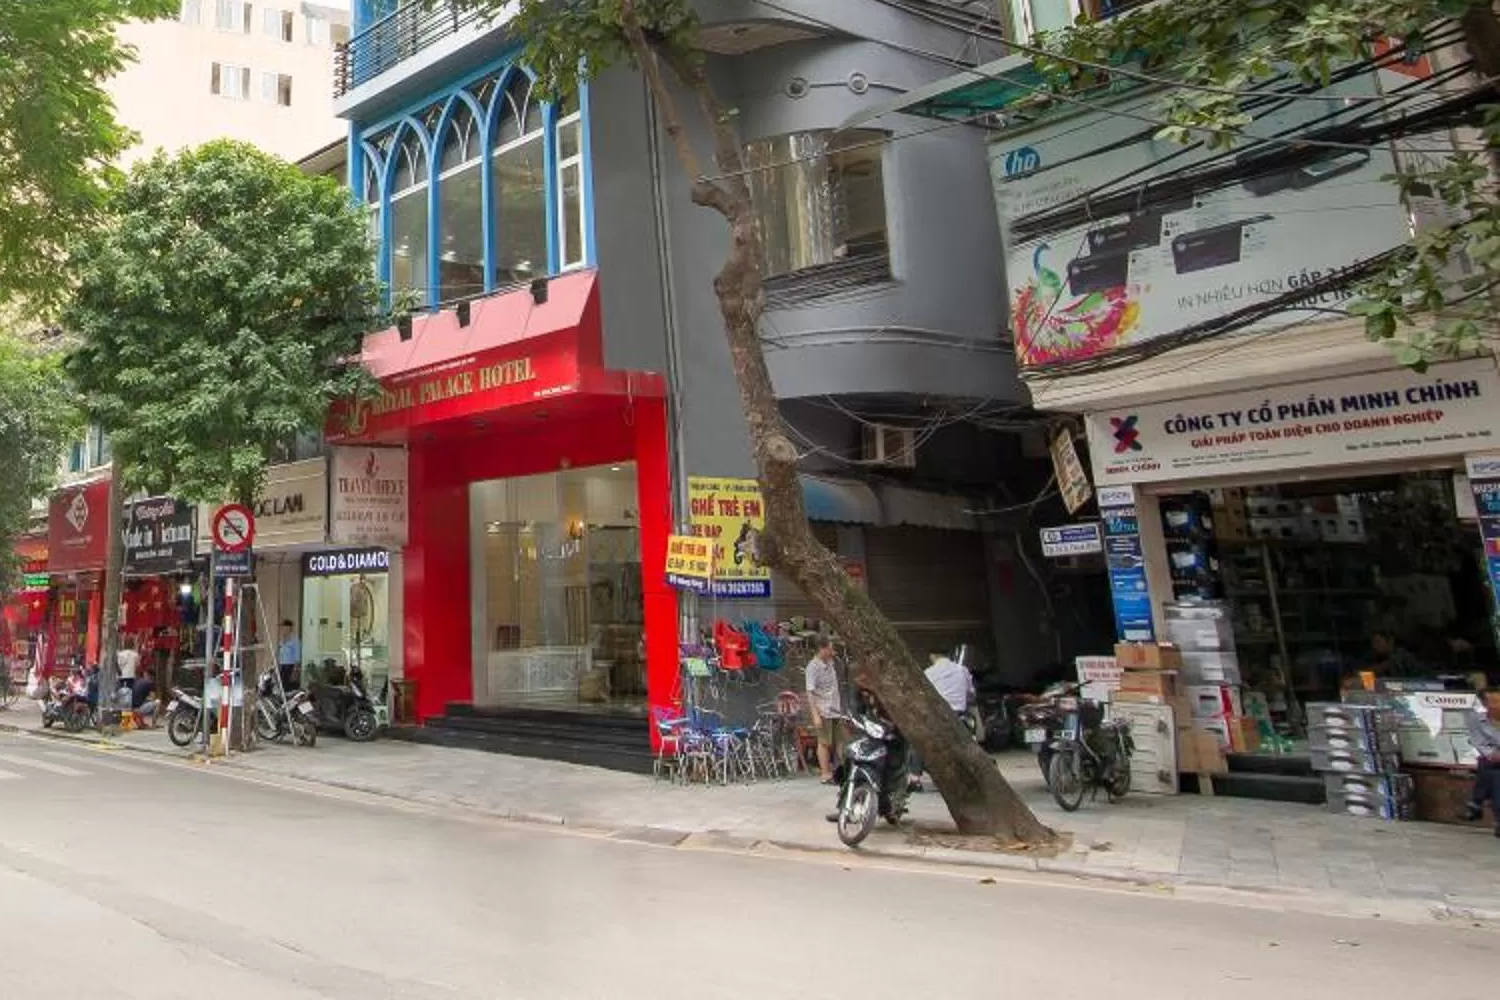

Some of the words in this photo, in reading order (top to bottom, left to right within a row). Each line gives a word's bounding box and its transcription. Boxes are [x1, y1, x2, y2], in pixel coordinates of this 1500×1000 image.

[419, 371, 474, 405] PALACE
[479, 357, 537, 391] HOTEL
[1164, 413, 1214, 435] CÔNG
[1217, 410, 1242, 428] TY
[1247, 400, 1273, 423] CỔ
[1277, 393, 1335, 420] PHẦN
[1341, 389, 1400, 413] MINH
[1405, 378, 1481, 405] CHÍNH
[1215, 431, 1246, 447] PHÁP
[1250, 427, 1281, 442] TOÀN
[1315, 421, 1342, 434] CHO
[1343, 417, 1391, 431] DOANH
[1393, 408, 1445, 426] NGHIỆP
[691, 493, 714, 517] GHẾ
[743, 499, 761, 519] EM
[1425, 692, 1467, 705] Canon
